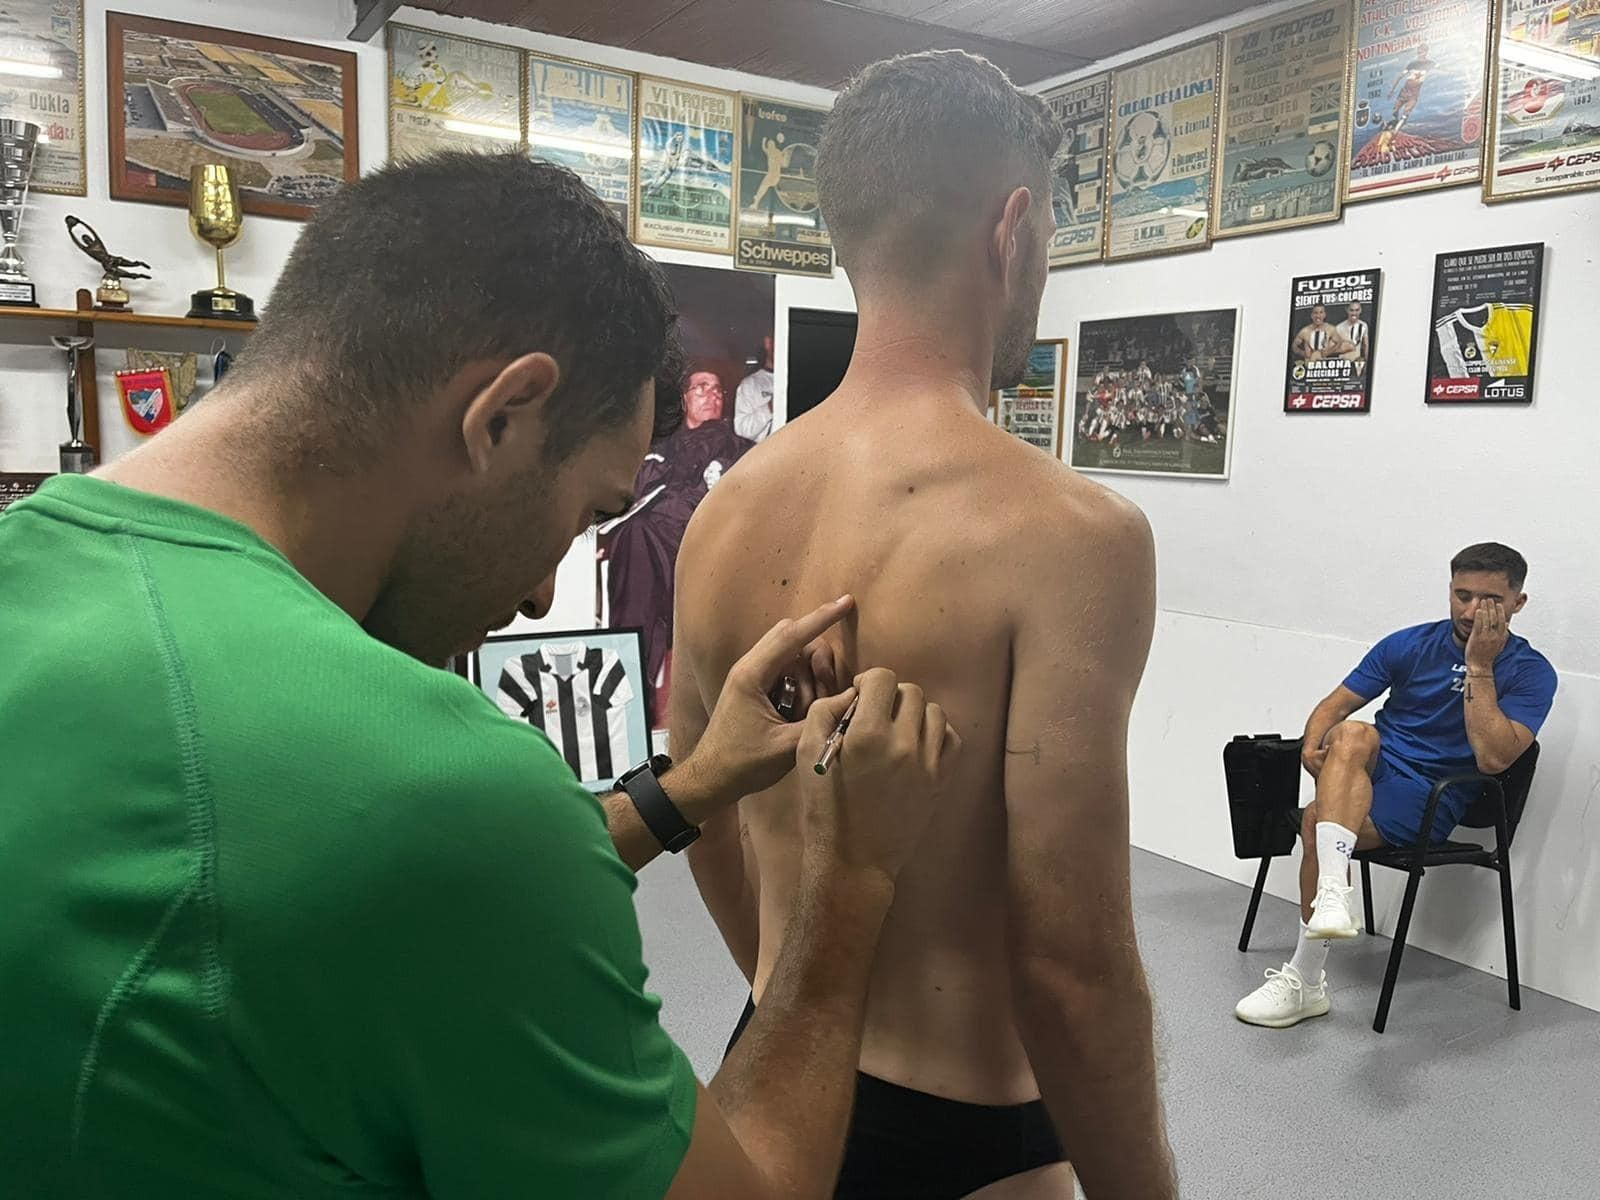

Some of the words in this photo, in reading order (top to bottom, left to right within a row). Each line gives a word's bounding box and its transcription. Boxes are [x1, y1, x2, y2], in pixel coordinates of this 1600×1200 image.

[1183, 78, 1213, 99] LINEA
[30, 91, 70, 114] Dukla
[1566, 150, 1600, 167] CEPS
[740, 240, 830, 268] Schweppes
[1298, 275, 1372, 293] FUTBOL
[1295, 294, 1320, 307] SIENTE
[1322, 293, 1337, 304] TUS
[1338, 288, 1373, 302] COLORES
[1446, 384, 1478, 395] CEPSA
[1484, 387, 1524, 398] LOTUS
[1311, 394, 1361, 409] CEPSA
